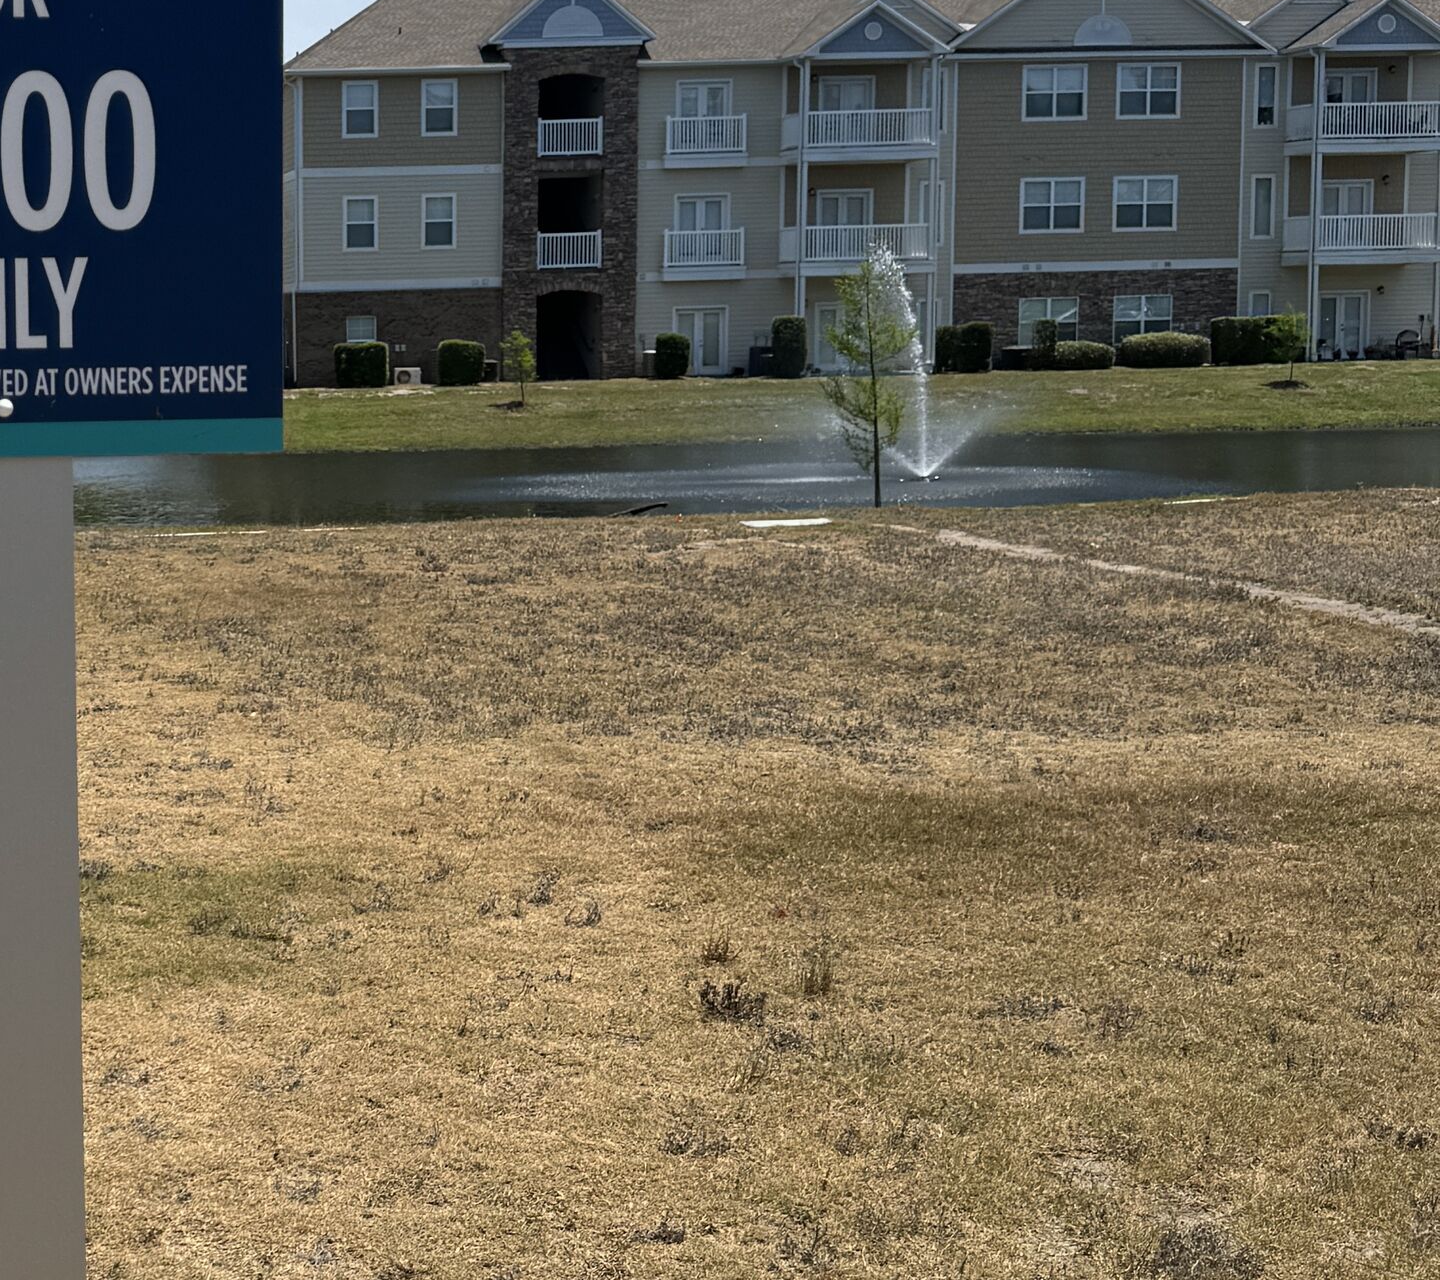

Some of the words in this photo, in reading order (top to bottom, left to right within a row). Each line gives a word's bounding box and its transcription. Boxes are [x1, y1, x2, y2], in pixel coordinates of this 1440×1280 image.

[35, 369, 58, 395] AT
[65, 367, 153, 395] OWNERS
[160, 365, 247, 393] EXPENSE
